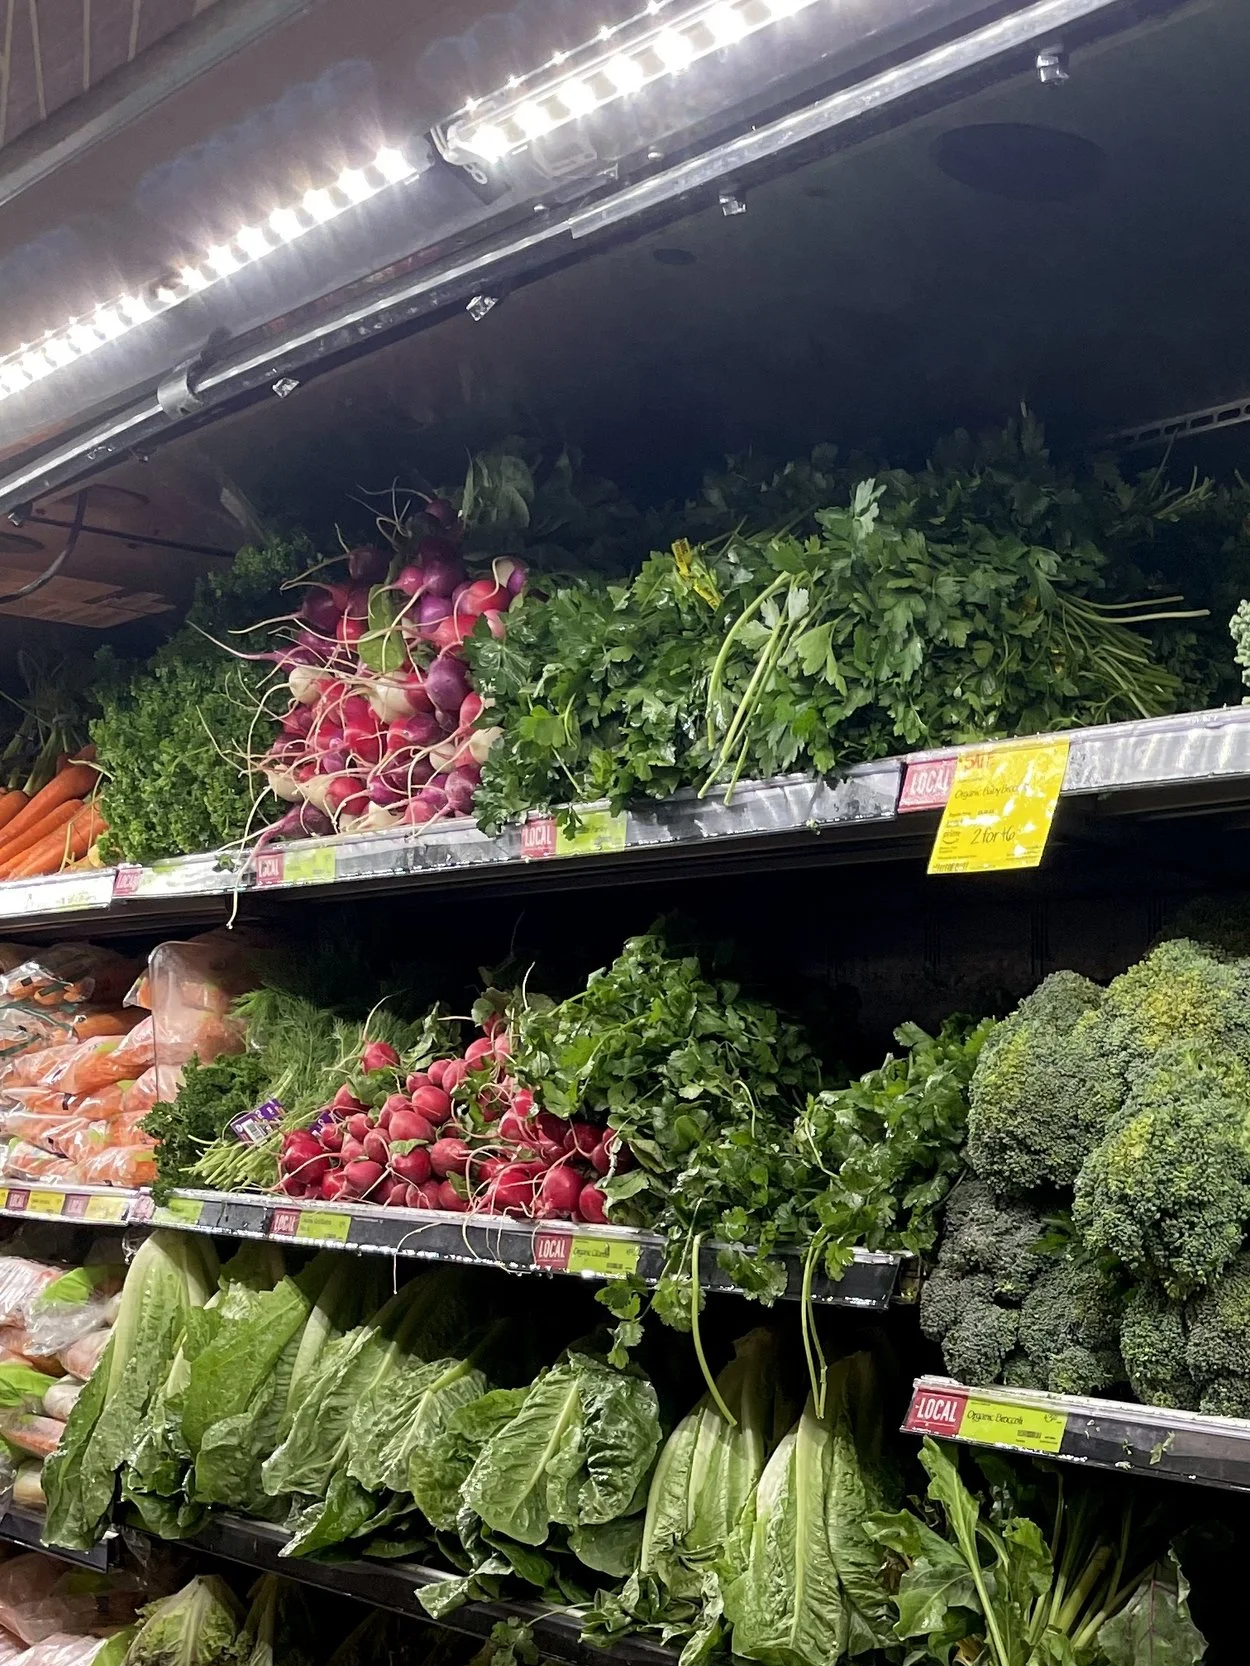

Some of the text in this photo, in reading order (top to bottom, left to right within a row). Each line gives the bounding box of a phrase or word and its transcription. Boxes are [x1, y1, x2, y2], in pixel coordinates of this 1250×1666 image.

[910, 764, 949, 796] LOCAL
[524, 825, 552, 847] LOCAL
[971, 829, 981, 845] 2
[983, 828, 1001, 843] for
[539, 1240, 565, 1258] LOCAL
[917, 1398, 957, 1423] LOCAL
[967, 1410, 1024, 1425] Organic Broccoli
